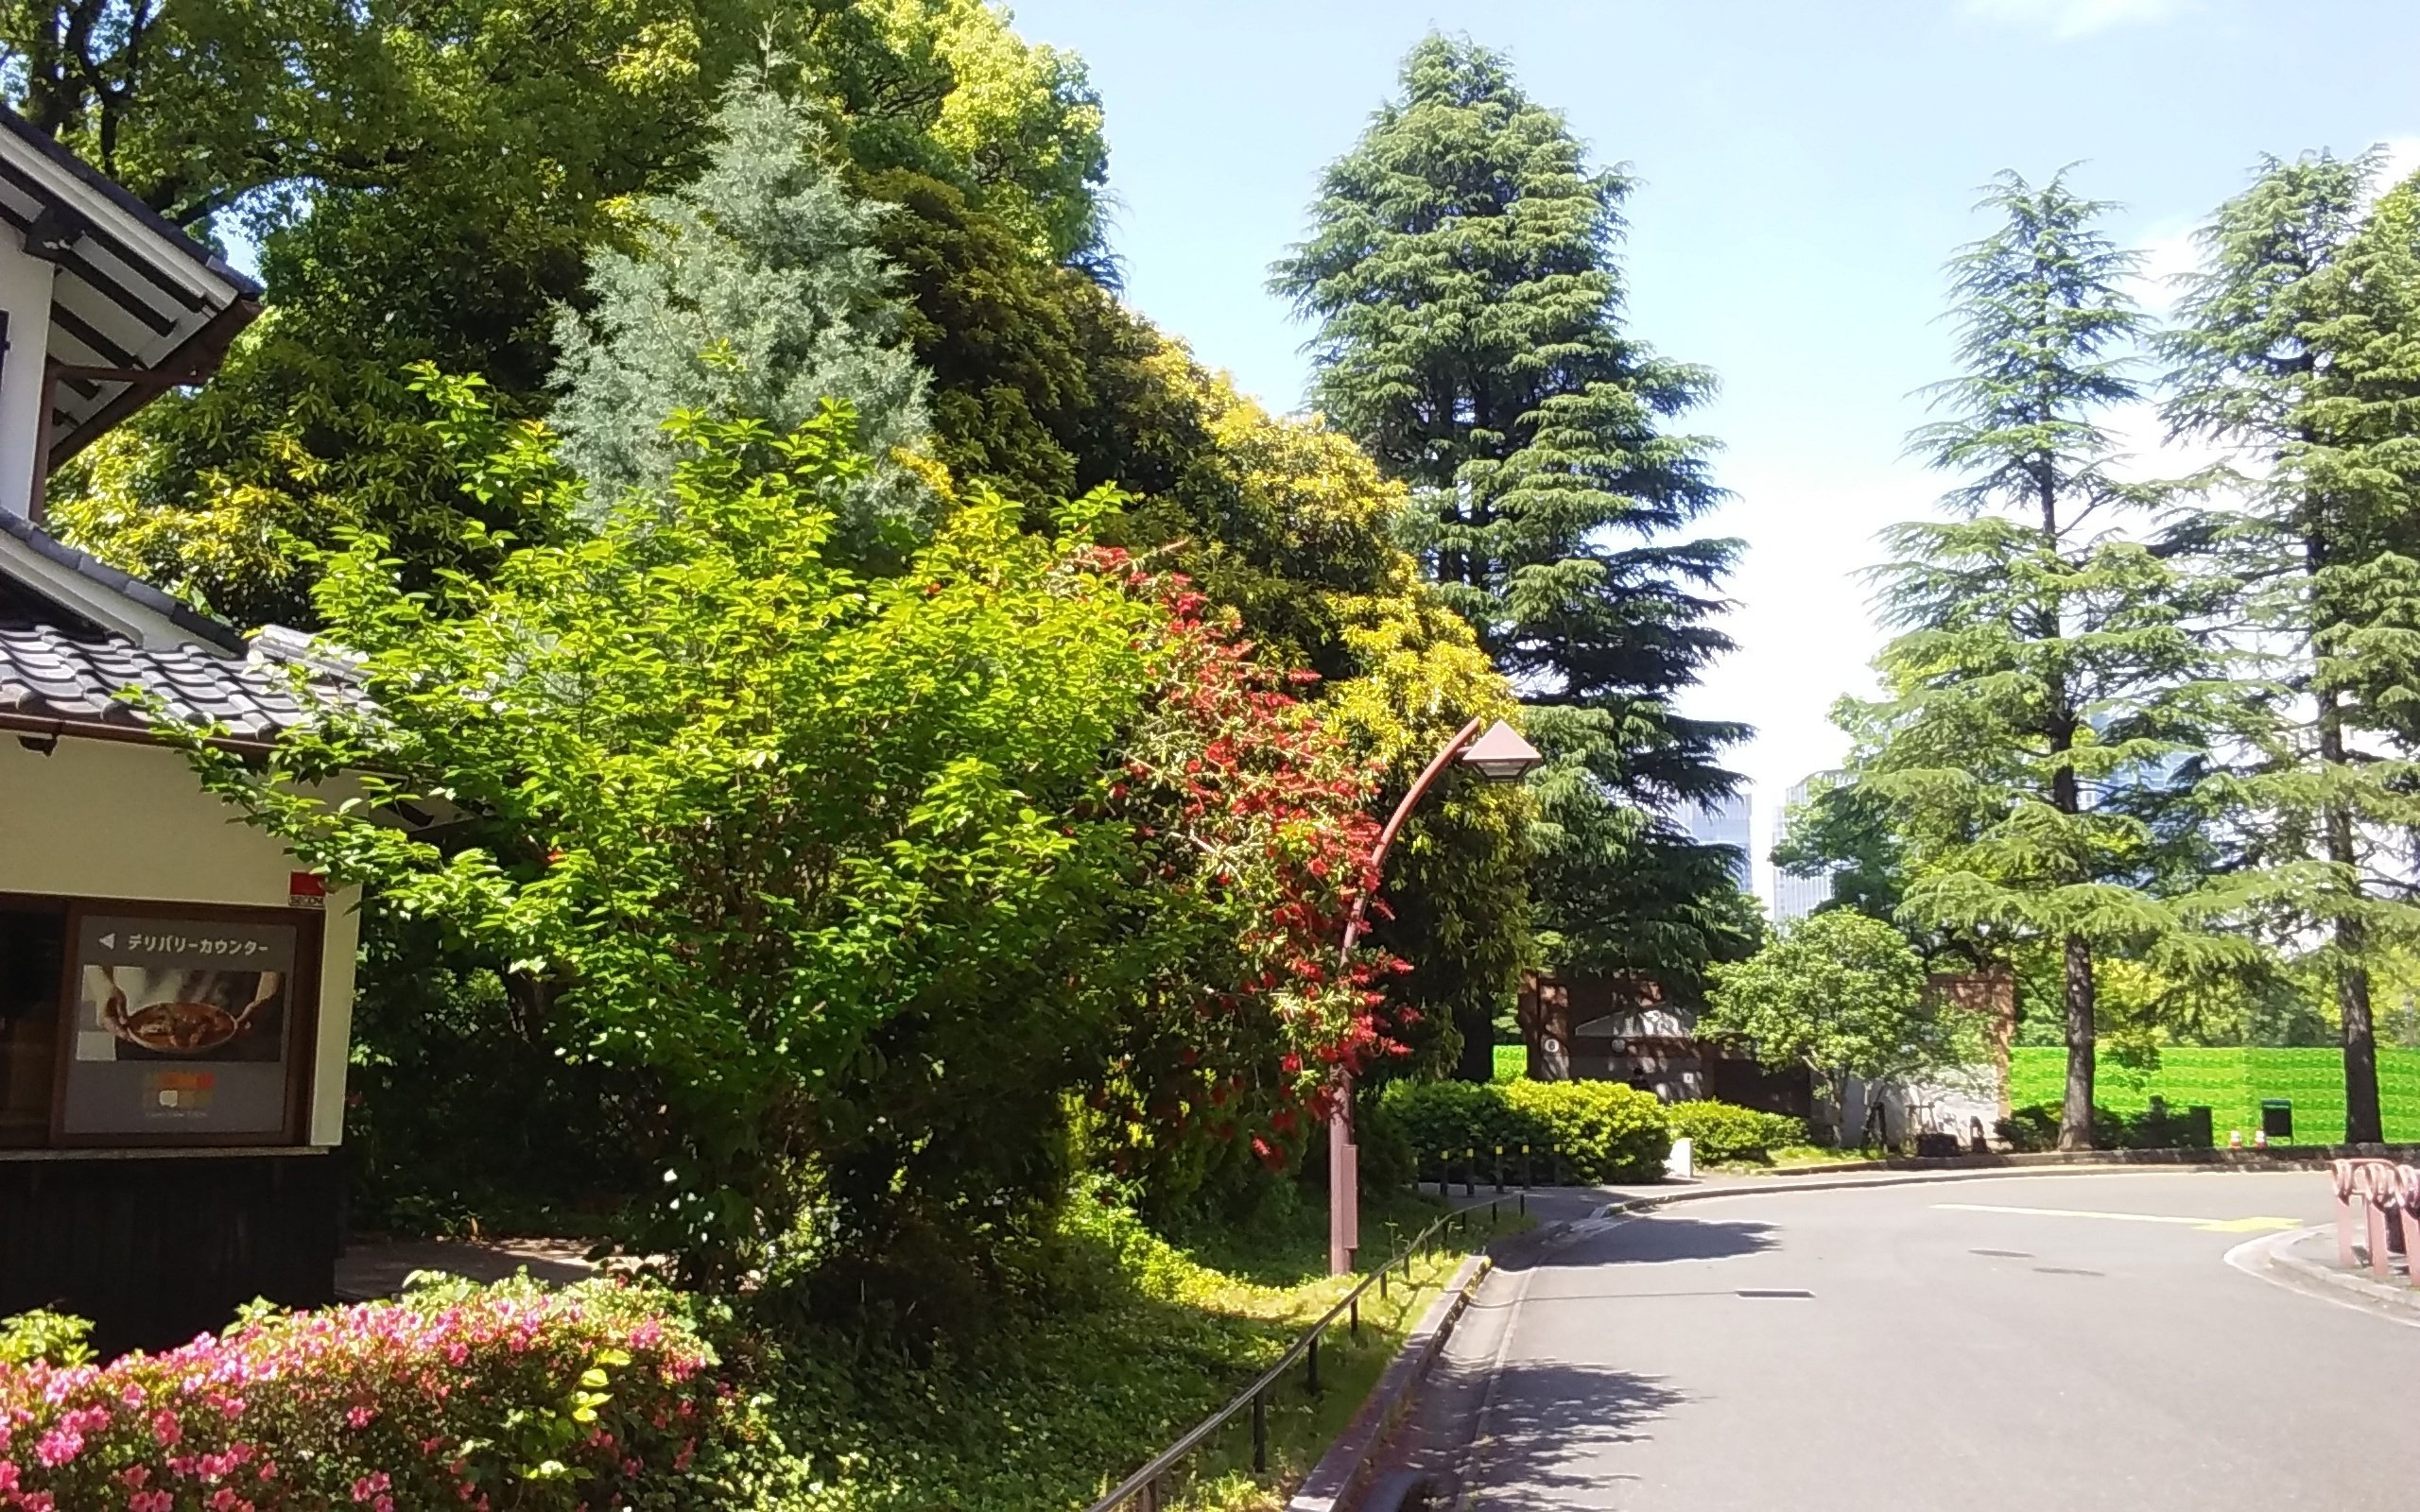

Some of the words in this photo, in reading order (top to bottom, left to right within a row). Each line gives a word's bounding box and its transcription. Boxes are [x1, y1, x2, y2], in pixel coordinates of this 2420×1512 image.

[128, 933, 268, 955] デリバリーカウンター
